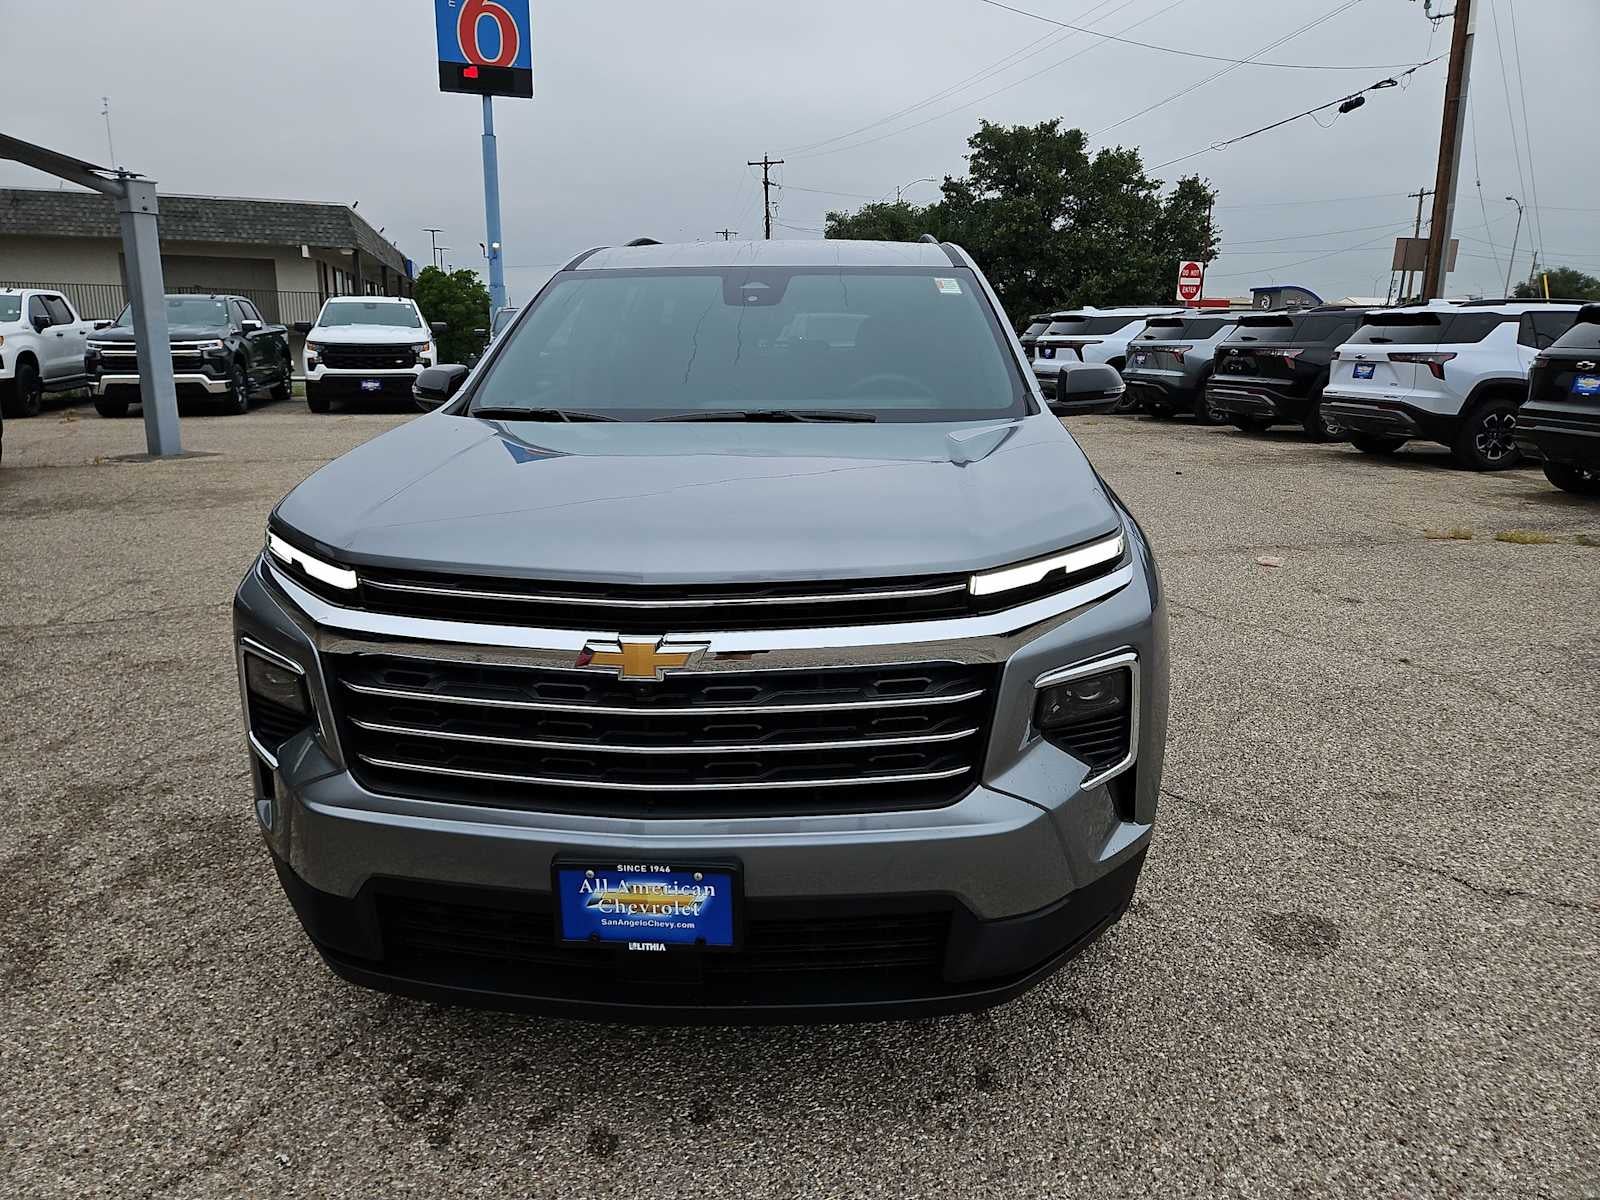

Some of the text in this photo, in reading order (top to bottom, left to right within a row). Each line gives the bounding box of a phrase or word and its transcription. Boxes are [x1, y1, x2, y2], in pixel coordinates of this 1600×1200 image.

[457, 0, 520, 67] 6
[1182, 286, 1197, 294] ENTER
[616, 864, 671, 873] SINCE 1946
[579, 878, 716, 897] All American
[599, 898, 700, 916] Chevrolet
[601, 918, 695, 929] SanAngeloChevy.com
